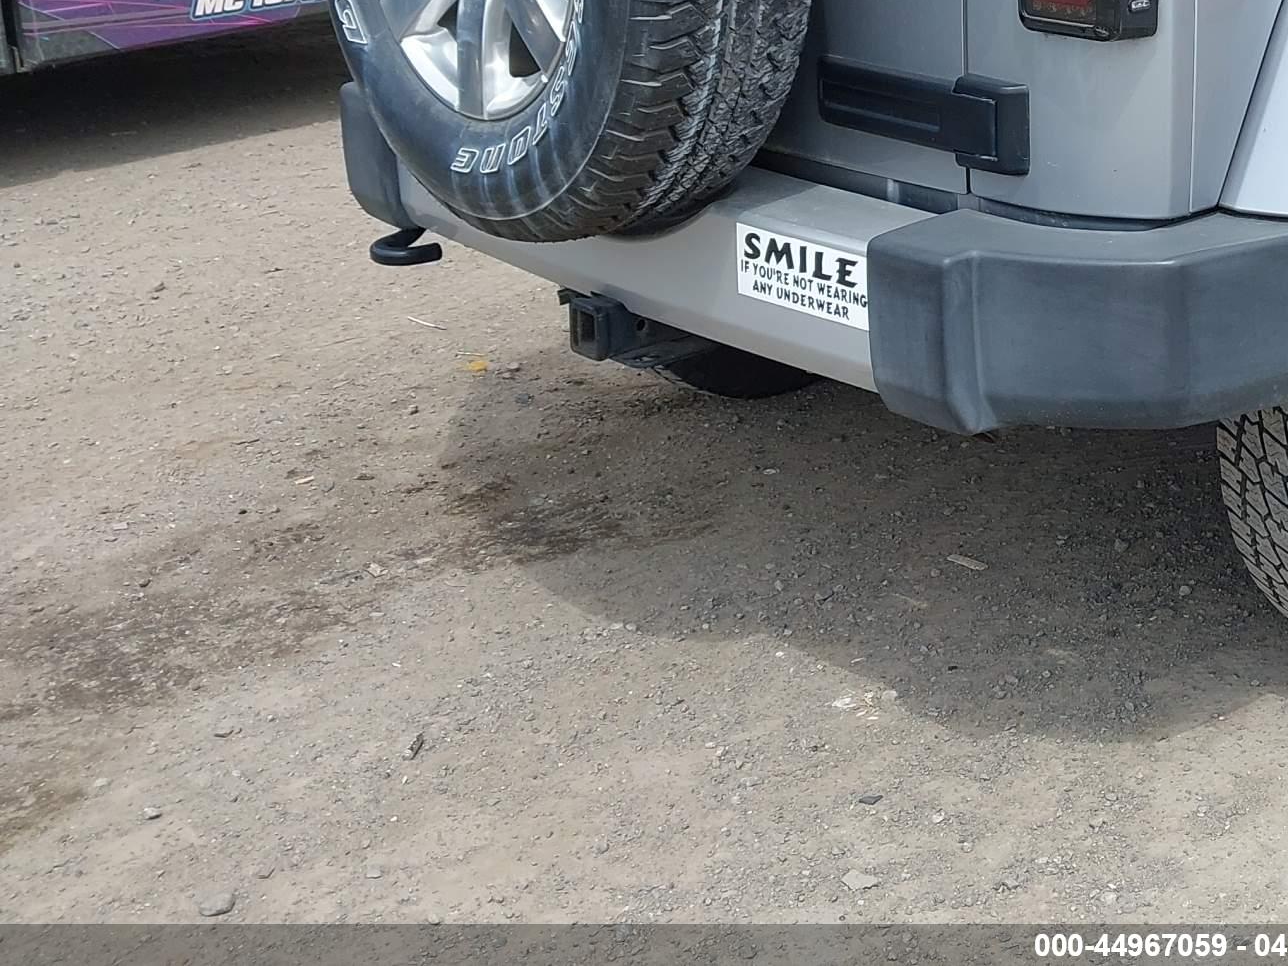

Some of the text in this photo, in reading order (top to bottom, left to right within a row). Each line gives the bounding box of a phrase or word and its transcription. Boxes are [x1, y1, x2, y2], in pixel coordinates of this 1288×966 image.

[741, 259, 868, 309] IF YOU'RE NOT WEARING
[743, 232, 859, 289] SMILE
[753, 279, 850, 321] ANY UNDERWEAR
